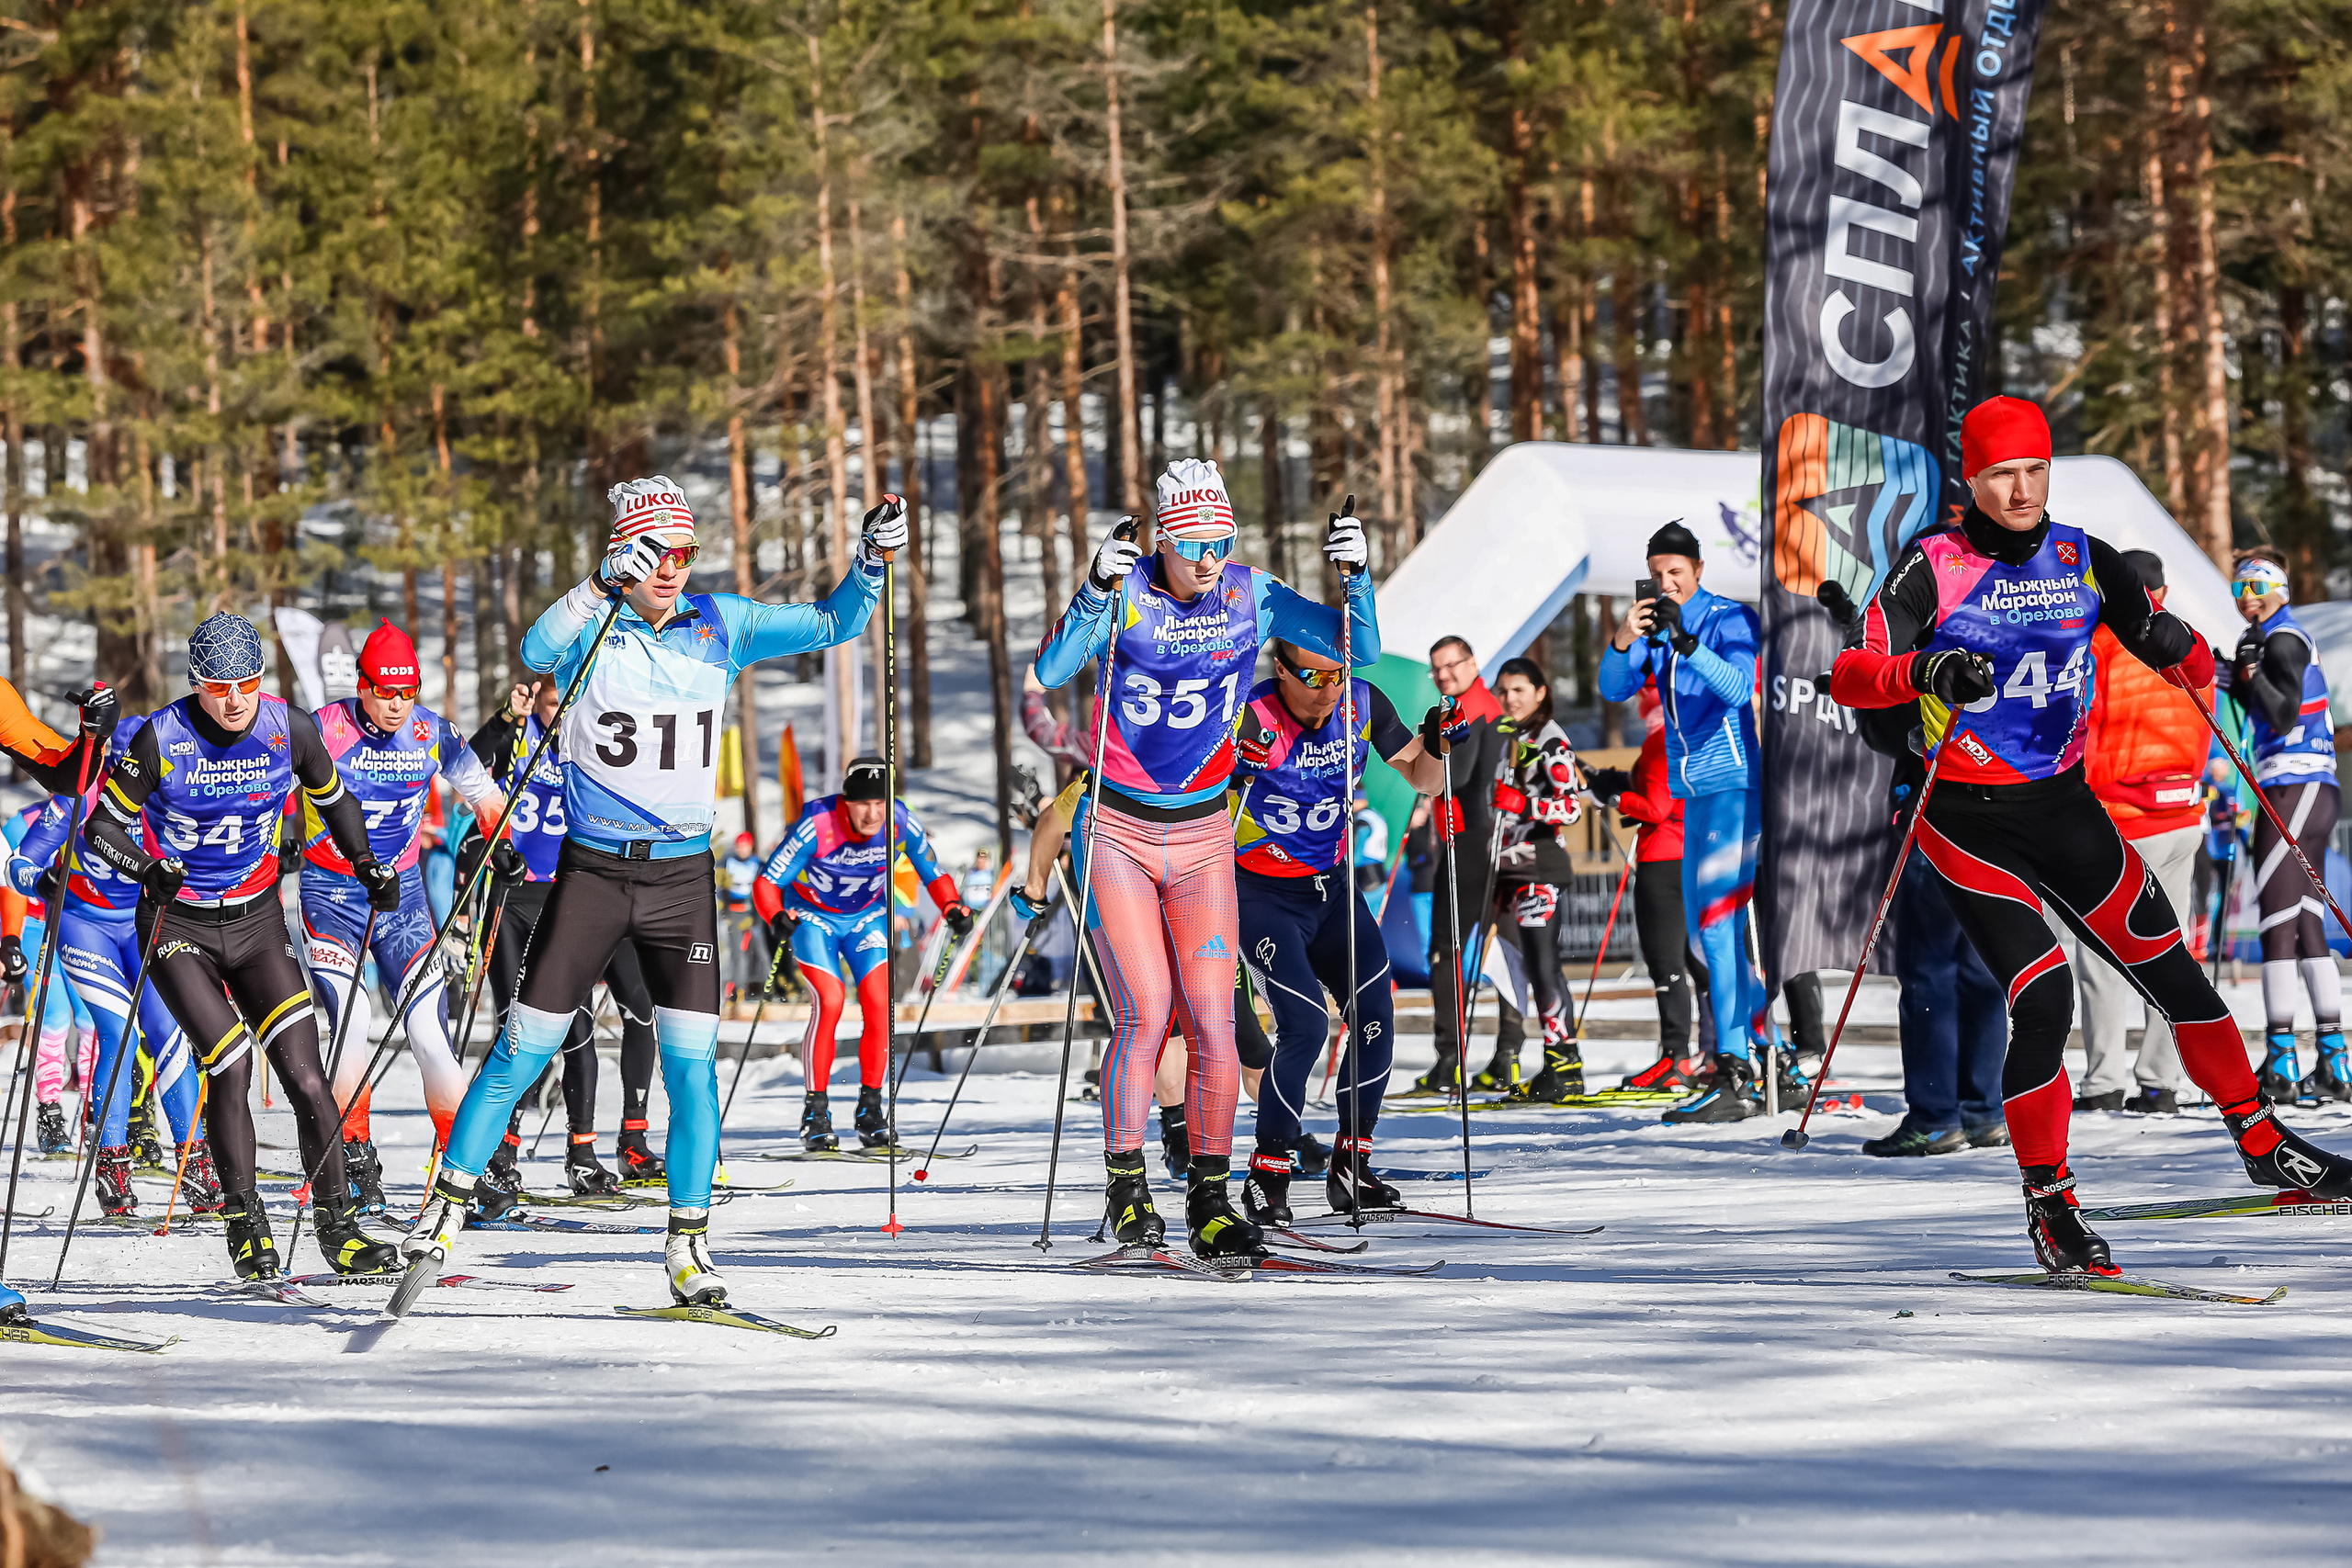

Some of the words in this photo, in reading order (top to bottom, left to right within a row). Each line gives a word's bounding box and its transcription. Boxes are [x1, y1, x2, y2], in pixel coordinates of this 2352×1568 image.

[1961, 88, 1996, 276] АКТИВНЫЙ
[1819, 0, 1960, 389] СПЛА
[627, 491, 686, 513] LUKOIL
[1170, 489, 1228, 507] LUKOIL
[1993, 571, 2080, 596] Лыжный
[1981, 589, 2078, 612] Марафон
[1161, 607, 1229, 630] Лыжный
[1990, 615, 2001, 626] в
[2006, 605, 2086, 626] Орехово
[2060, 618, 2086, 630] 2022
[1151, 625, 1228, 643] Марафон
[1156, 644, 1166, 655] в
[1170, 639, 1235, 658] Орехово
[1210, 649, 1234, 661] 2022
[379, 666, 414, 676] RODE
[1121, 670, 1242, 730] 351
[595, 709, 714, 771] 311
[195, 752, 271, 773] Лыжный
[362, 746, 427, 761] Лыжный
[349, 756, 424, 774] Марафон
[184, 768, 267, 785] Марафон
[354, 772, 363, 781] в
[367, 770, 426, 784] Орехово
[189, 788, 198, 797] в
[203, 782, 272, 798] Орехово
[247, 791, 272, 802] 2022
[360, 788, 424, 830] 77
[1262, 794, 1348, 835] 36
[163, 807, 277, 855] 341
[767, 836, 804, 880] LUKOIL
[157, 939, 183, 959] RUN
[1194, 948, 1232, 959] adidas
[311, 953, 343, 968] TEAM
[1106, 1166, 1145, 1176] FISCHER
[2278, 1204, 2352, 1217] FISCHE
[1210, 1256, 1253, 1269] ROSSIGNOL
[338, 1277, 402, 1286] MADSHUS
[687, 1308, 714, 1320] FISCHER
[0, 1328, 30, 1342] HER
